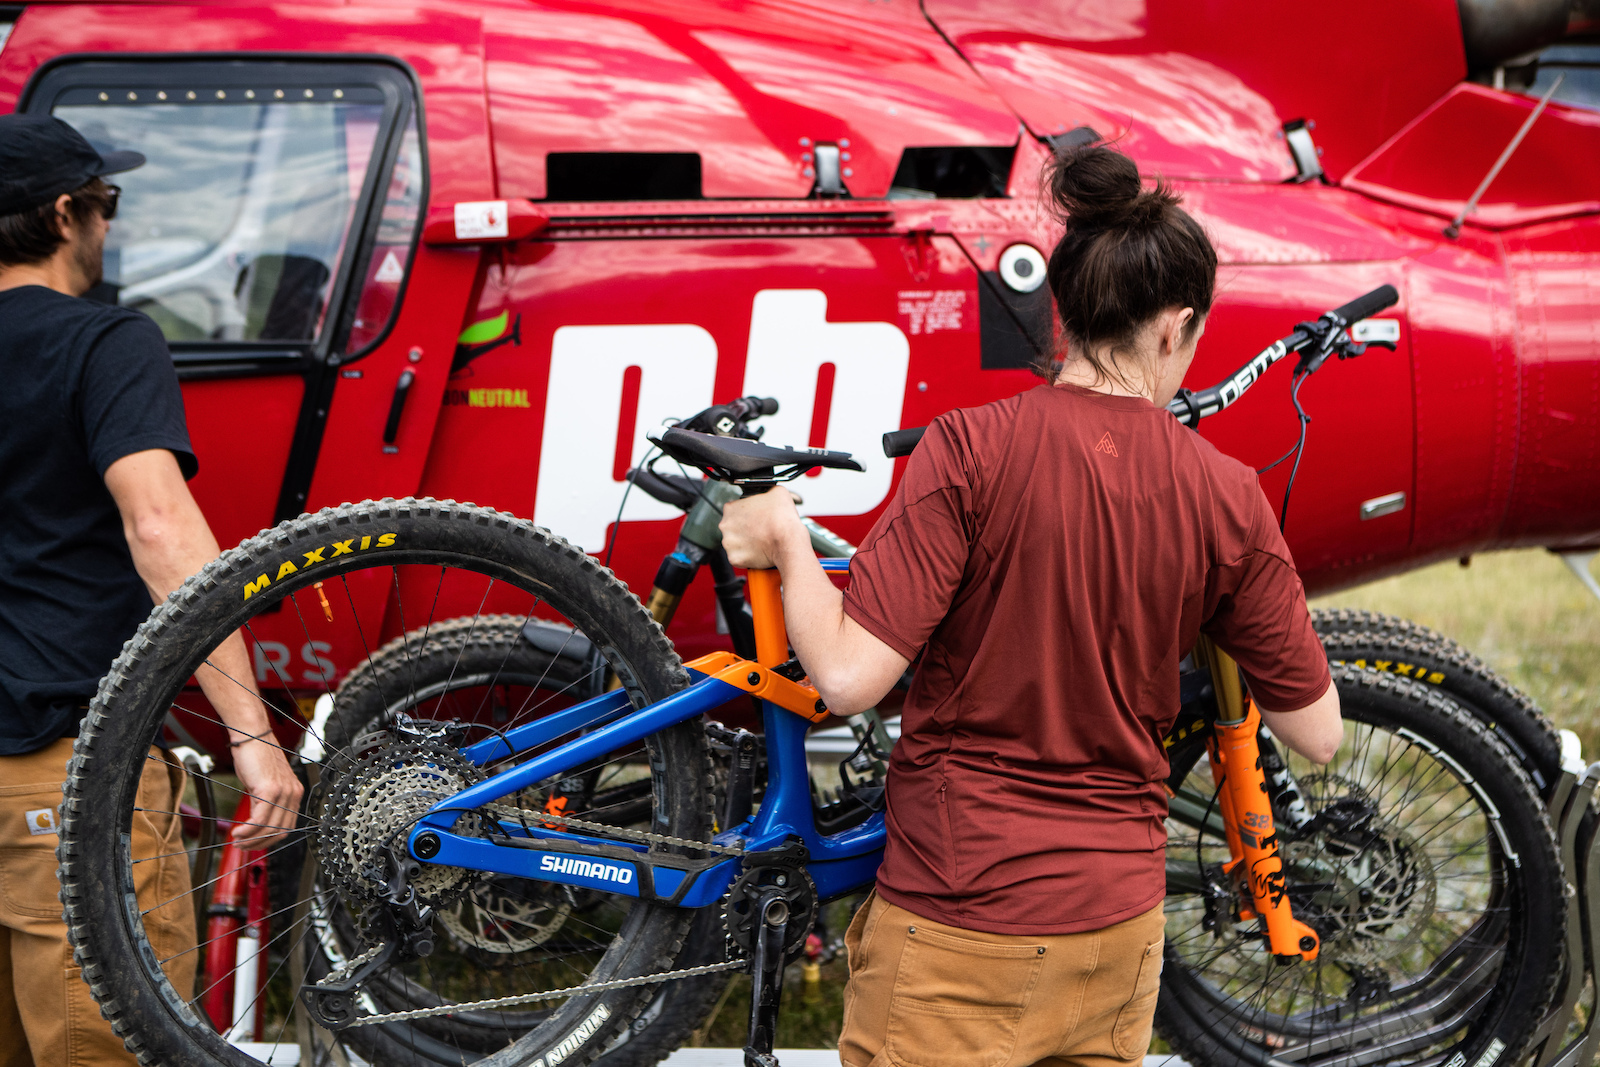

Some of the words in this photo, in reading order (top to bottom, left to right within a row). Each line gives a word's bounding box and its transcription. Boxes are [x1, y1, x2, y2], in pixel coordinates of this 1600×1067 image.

[1219, 340, 1287, 409] DEITY
[244, 533, 397, 601] MAXXIS
[253, 641, 336, 682] RS
[1338, 659, 1446, 684] AXXIS
[540, 855, 632, 884] SHIMANO
